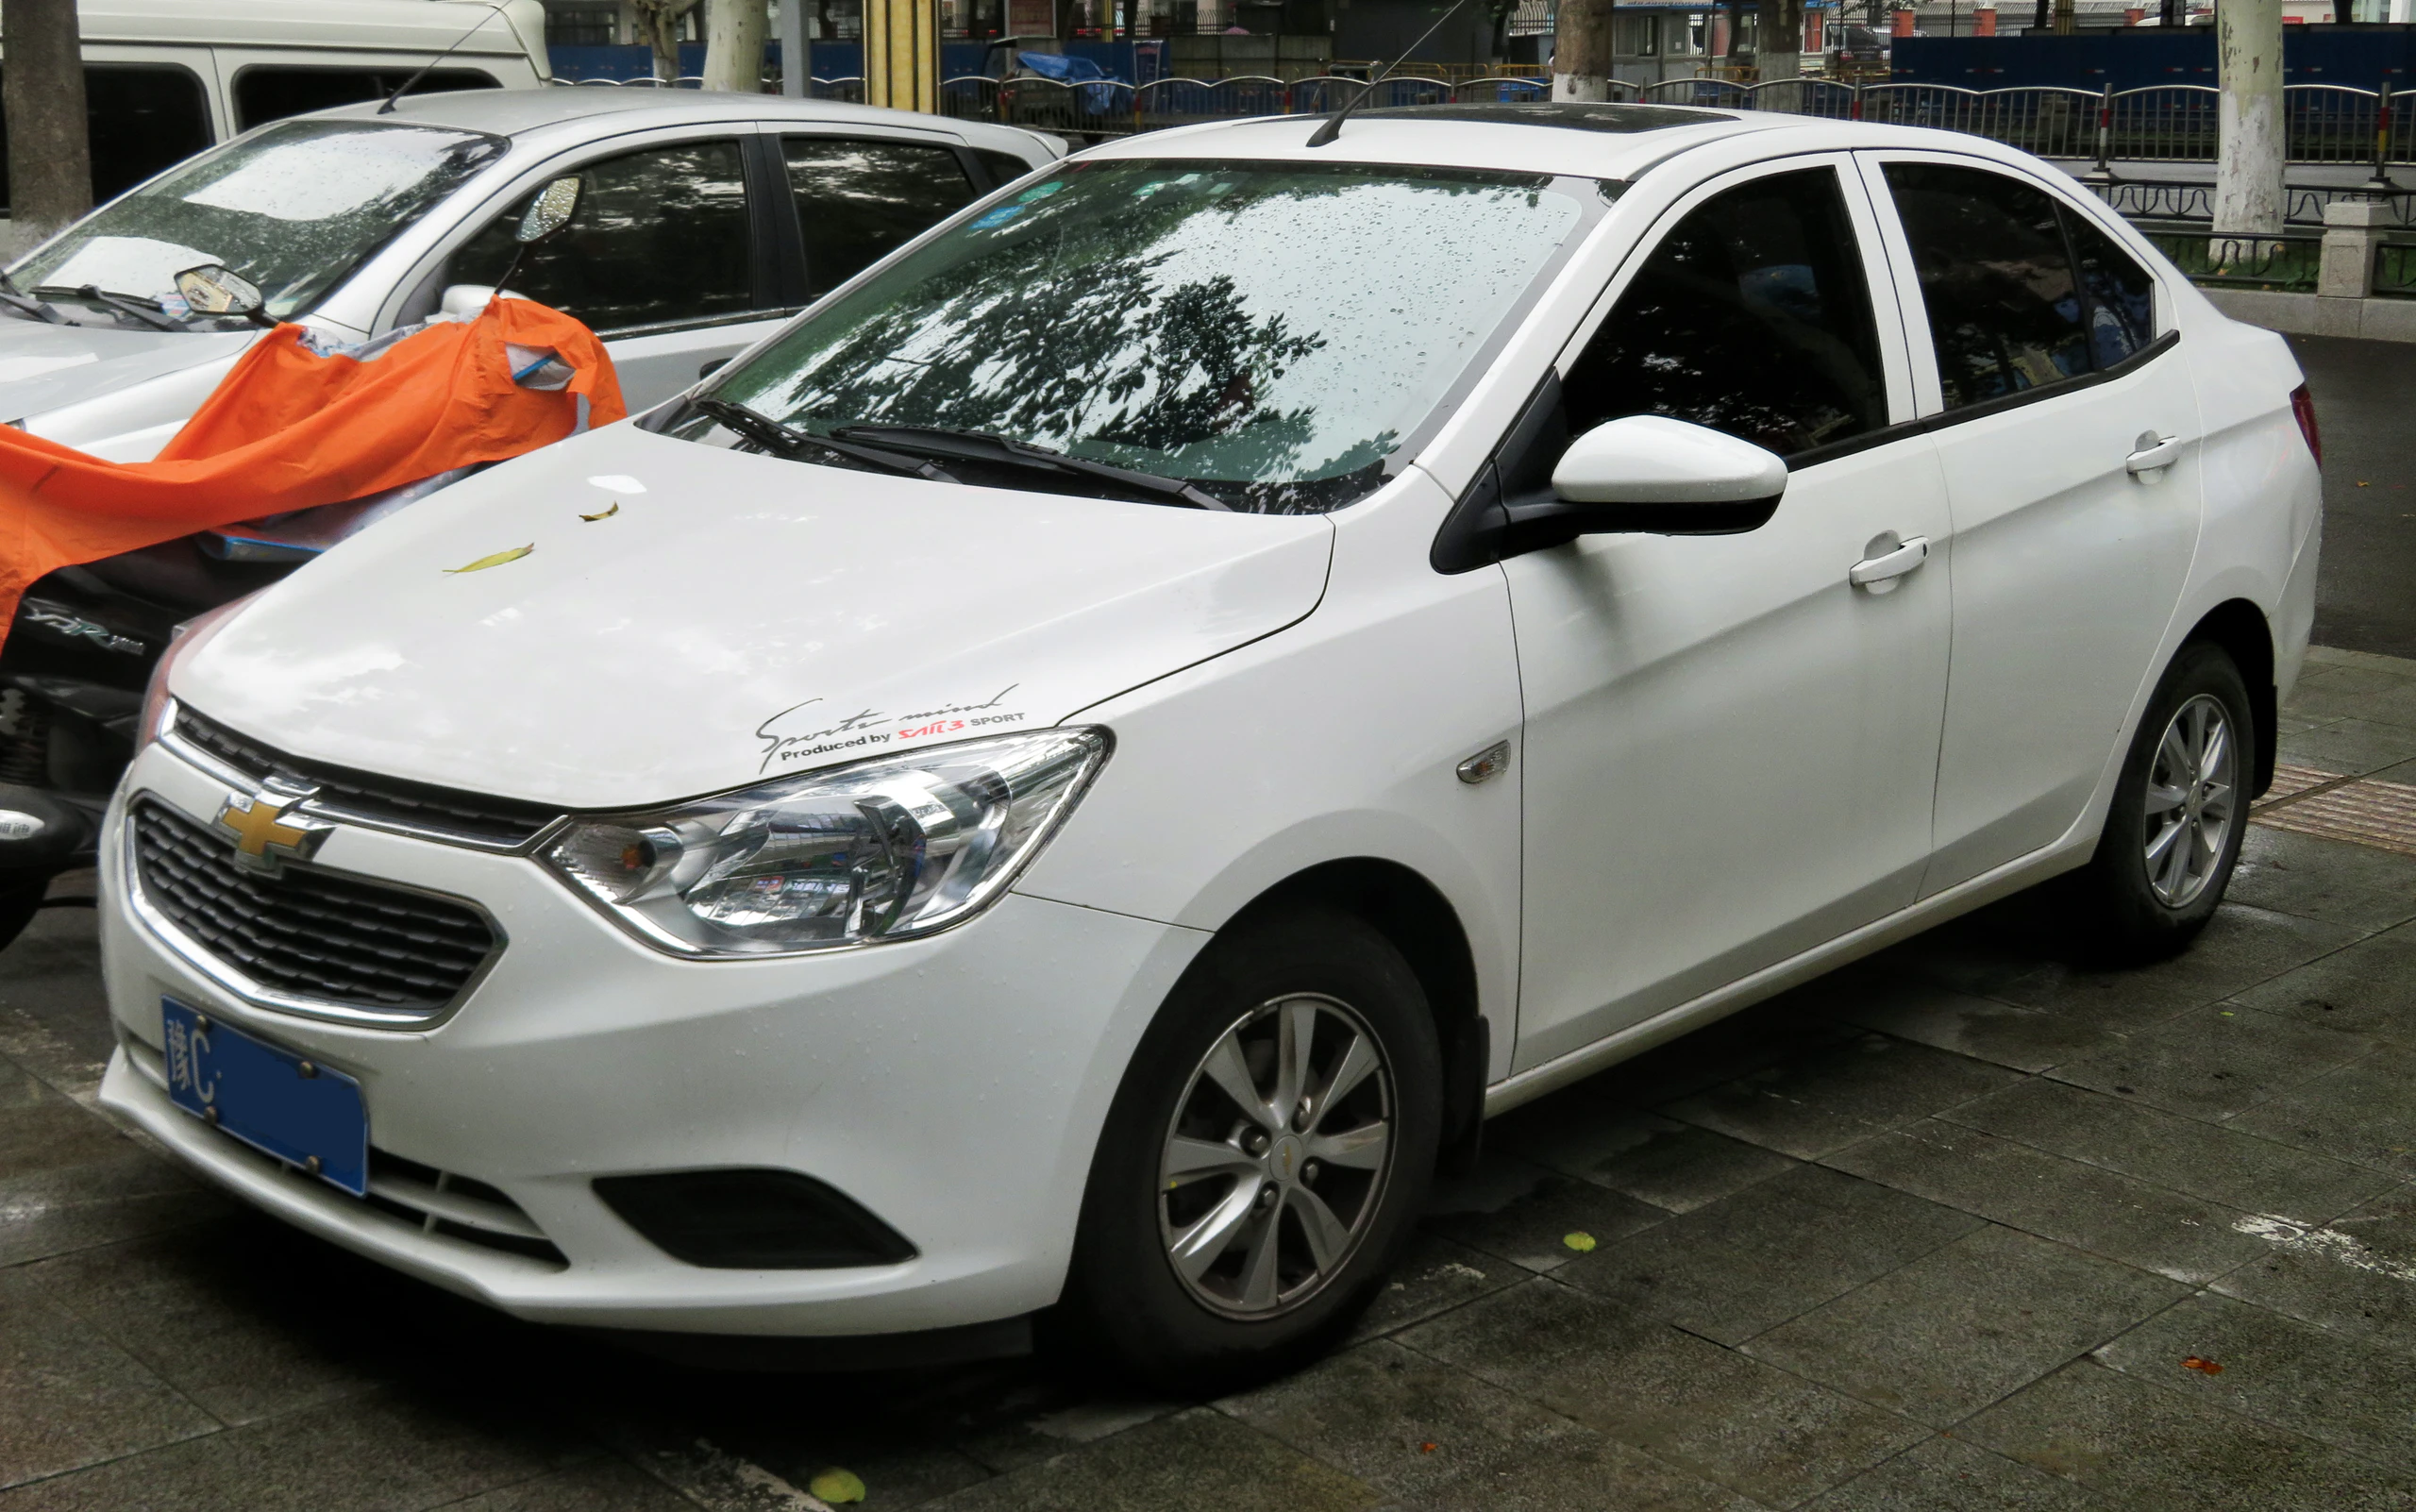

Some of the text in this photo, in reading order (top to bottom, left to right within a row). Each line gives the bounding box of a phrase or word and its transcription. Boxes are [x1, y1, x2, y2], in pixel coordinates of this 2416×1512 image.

[898, 682, 1020, 721] mind
[780, 735, 867, 761] Produced
[869, 732, 891, 744] by
[970, 712, 1026, 727] SPORT
